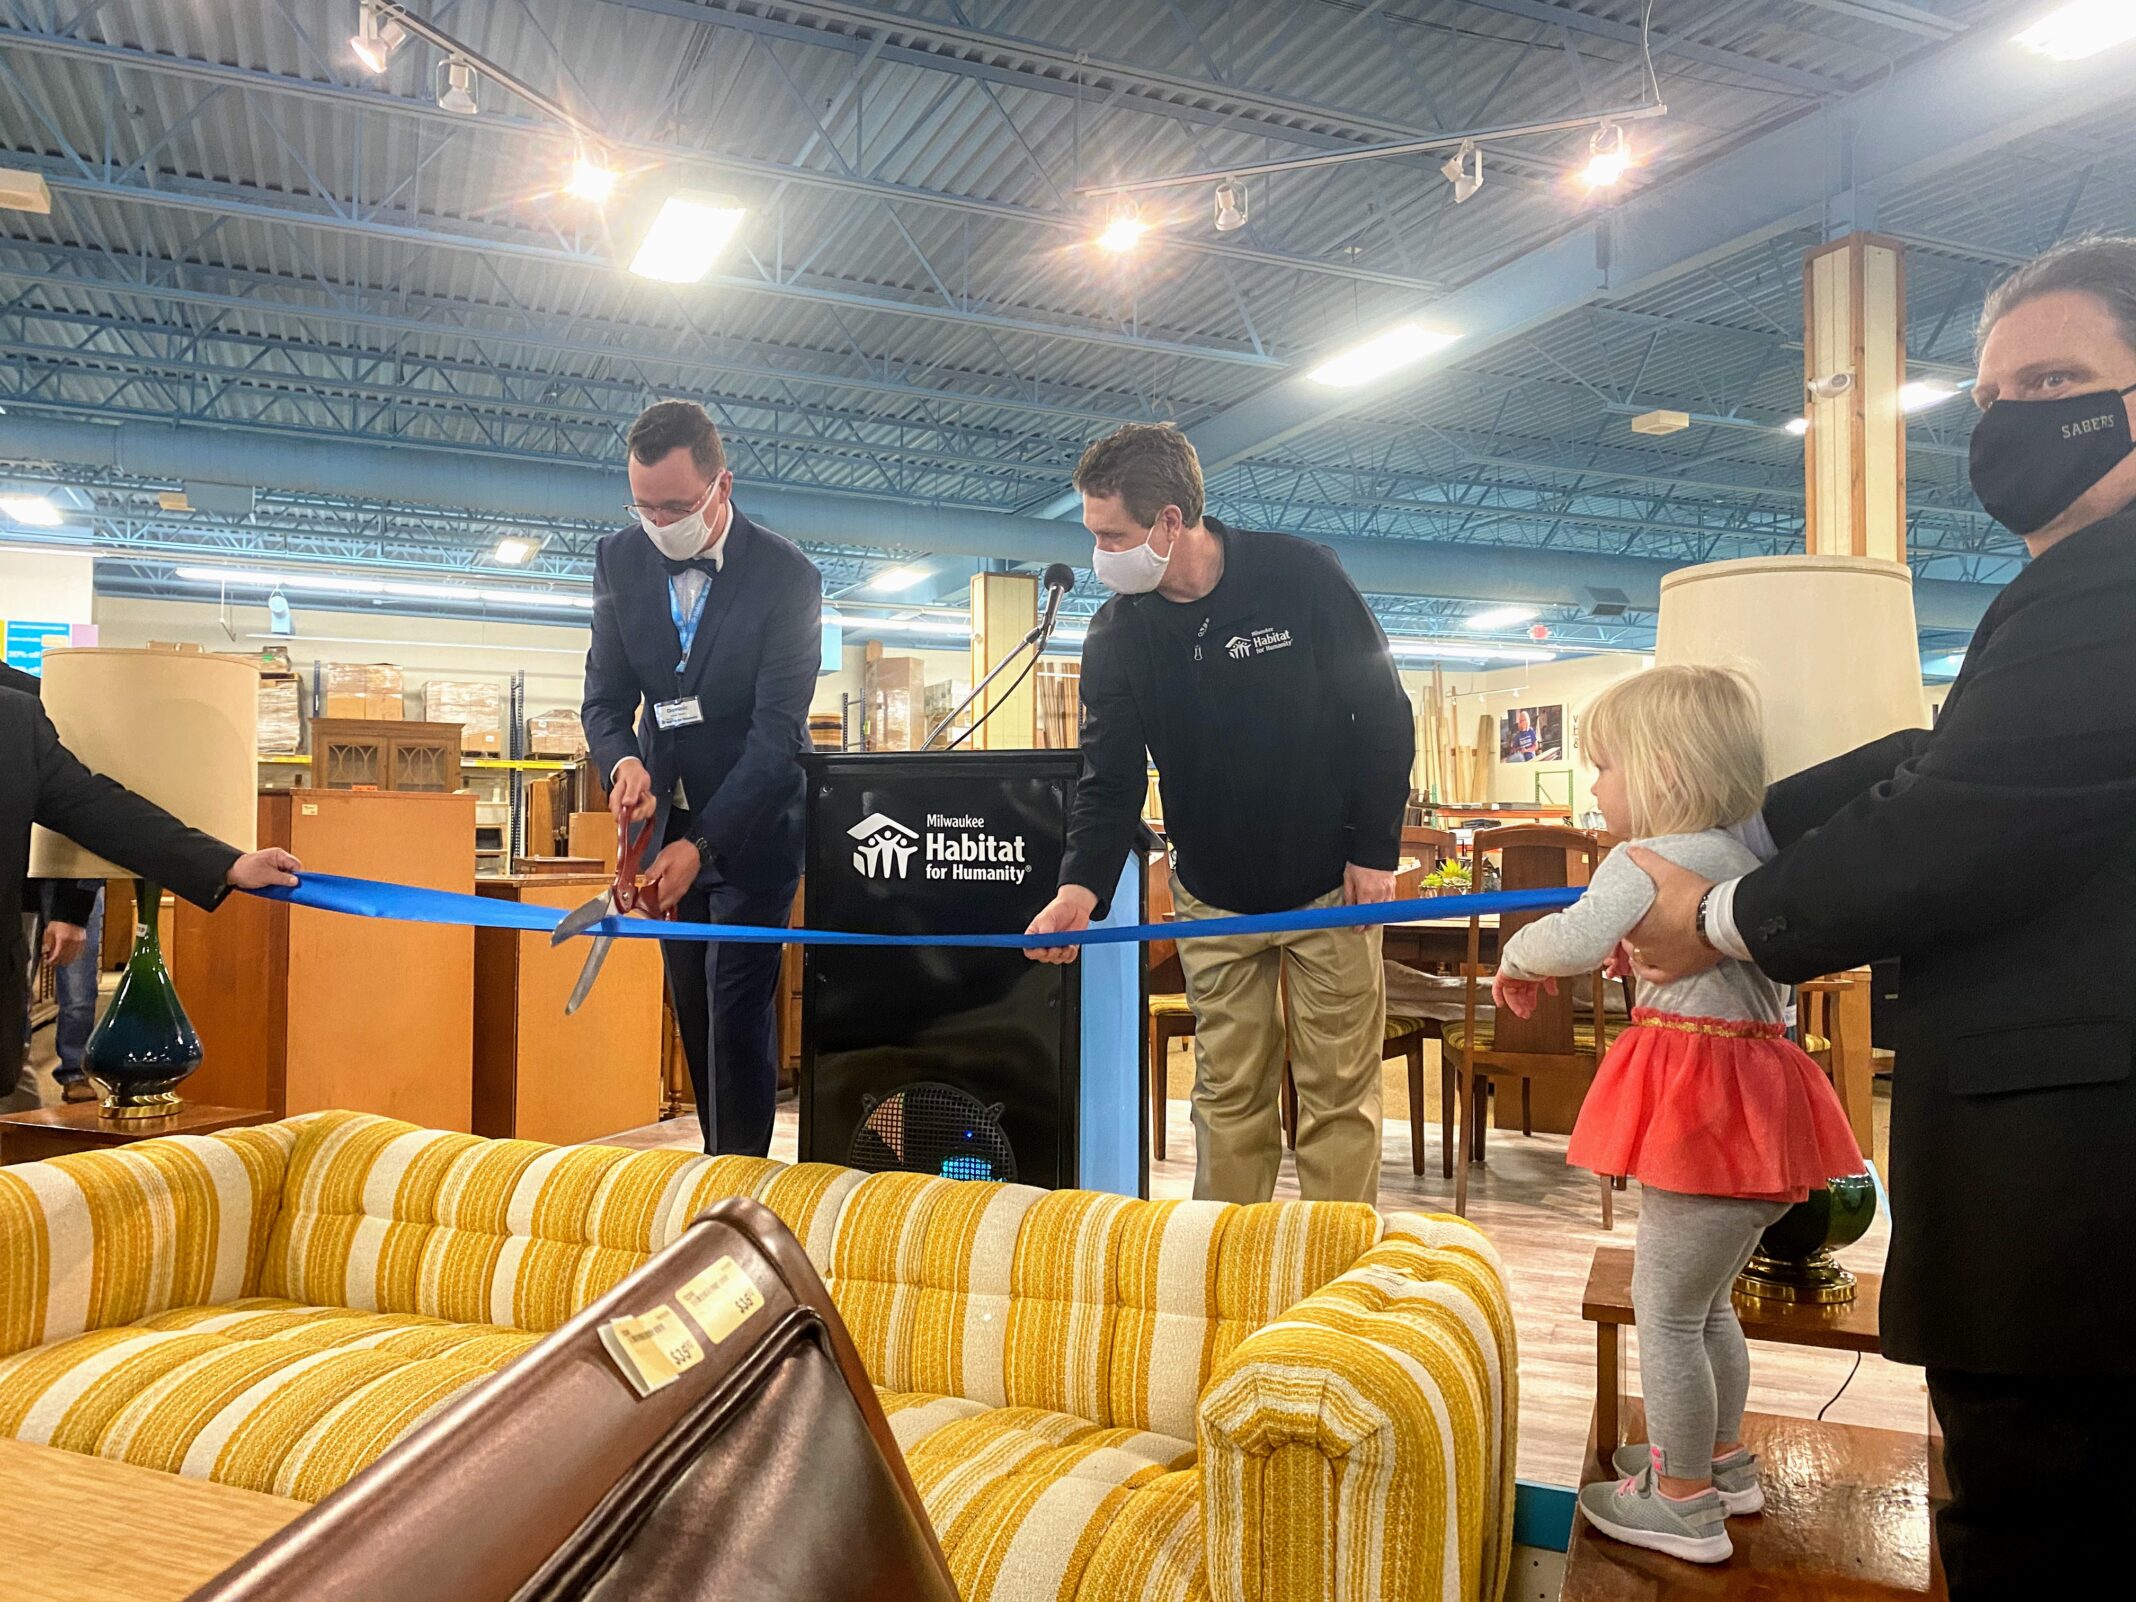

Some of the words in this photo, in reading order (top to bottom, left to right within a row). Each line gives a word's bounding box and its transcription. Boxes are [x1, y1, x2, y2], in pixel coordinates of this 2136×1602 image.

[2061, 414, 2115, 439] SABERS
[1253, 629, 1291, 648] Habitat
[926, 813, 985, 828] Milwaukee
[926, 833, 1026, 862] Habitat
[926, 864, 948, 880] for
